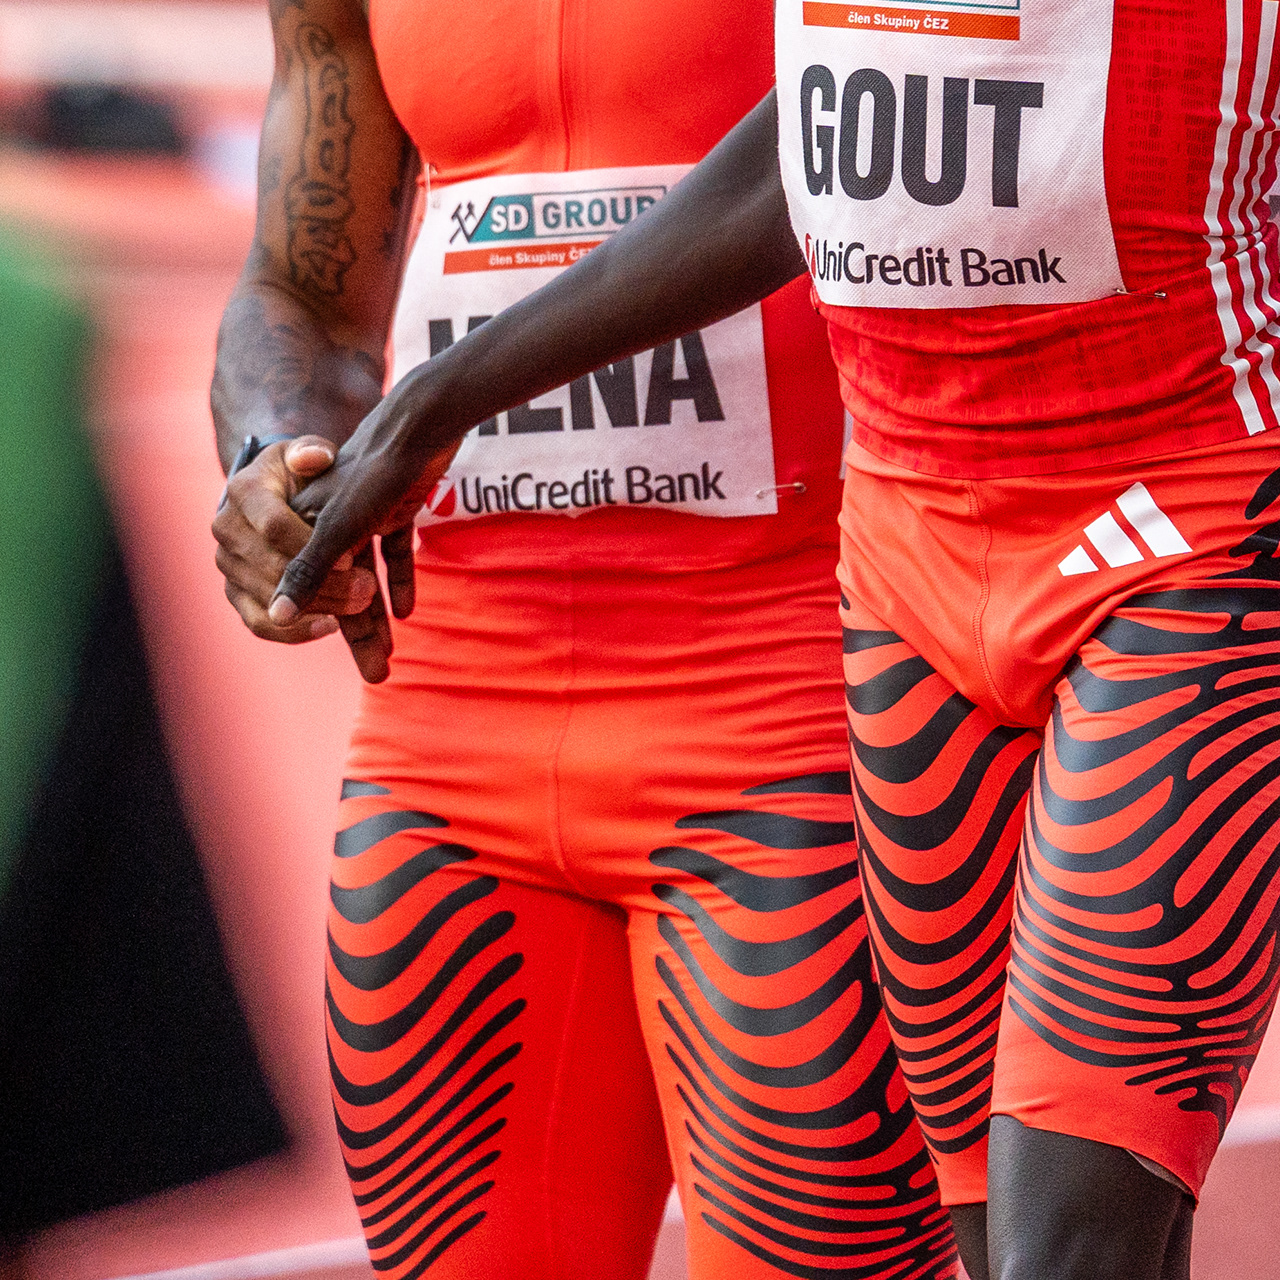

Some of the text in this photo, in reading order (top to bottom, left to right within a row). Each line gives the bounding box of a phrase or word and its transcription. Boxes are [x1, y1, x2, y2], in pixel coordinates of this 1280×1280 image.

[848, 11, 949, 30] člen Skupiny ČEZ
[801, 64, 1044, 208] GOUT
[490, 204, 531, 233] SD
[489, 247, 593, 267] člen Skupiny ČE
[816, 240, 1067, 287] UniCredit Bank
[461, 462, 727, 515] UniCredit Bank
